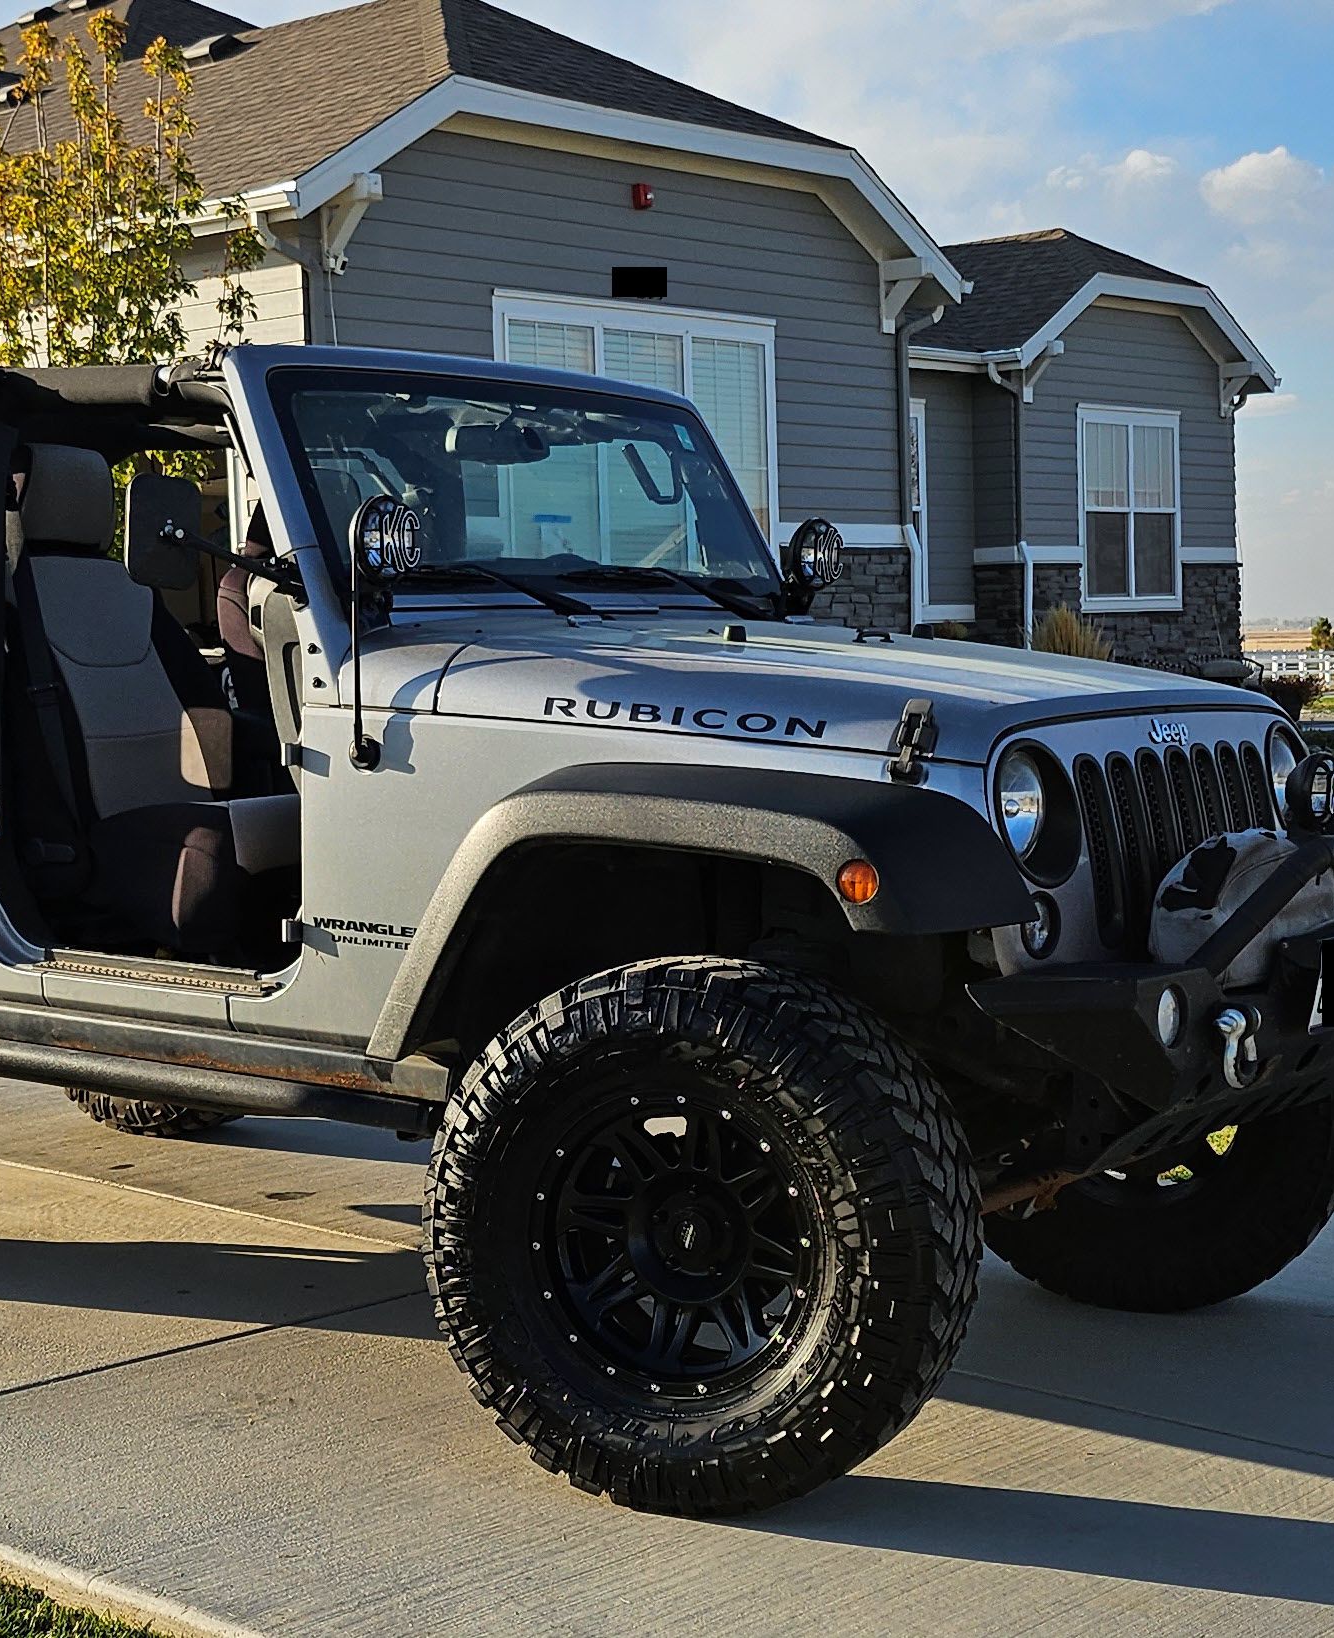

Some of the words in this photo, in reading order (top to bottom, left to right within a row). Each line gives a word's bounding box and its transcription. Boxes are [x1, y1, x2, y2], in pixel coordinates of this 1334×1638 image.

[382, 505, 421, 572] KC
[815, 527, 844, 583] KC
[543, 696, 828, 739] RUBICON
[1148, 718, 1189, 746] Jeep
